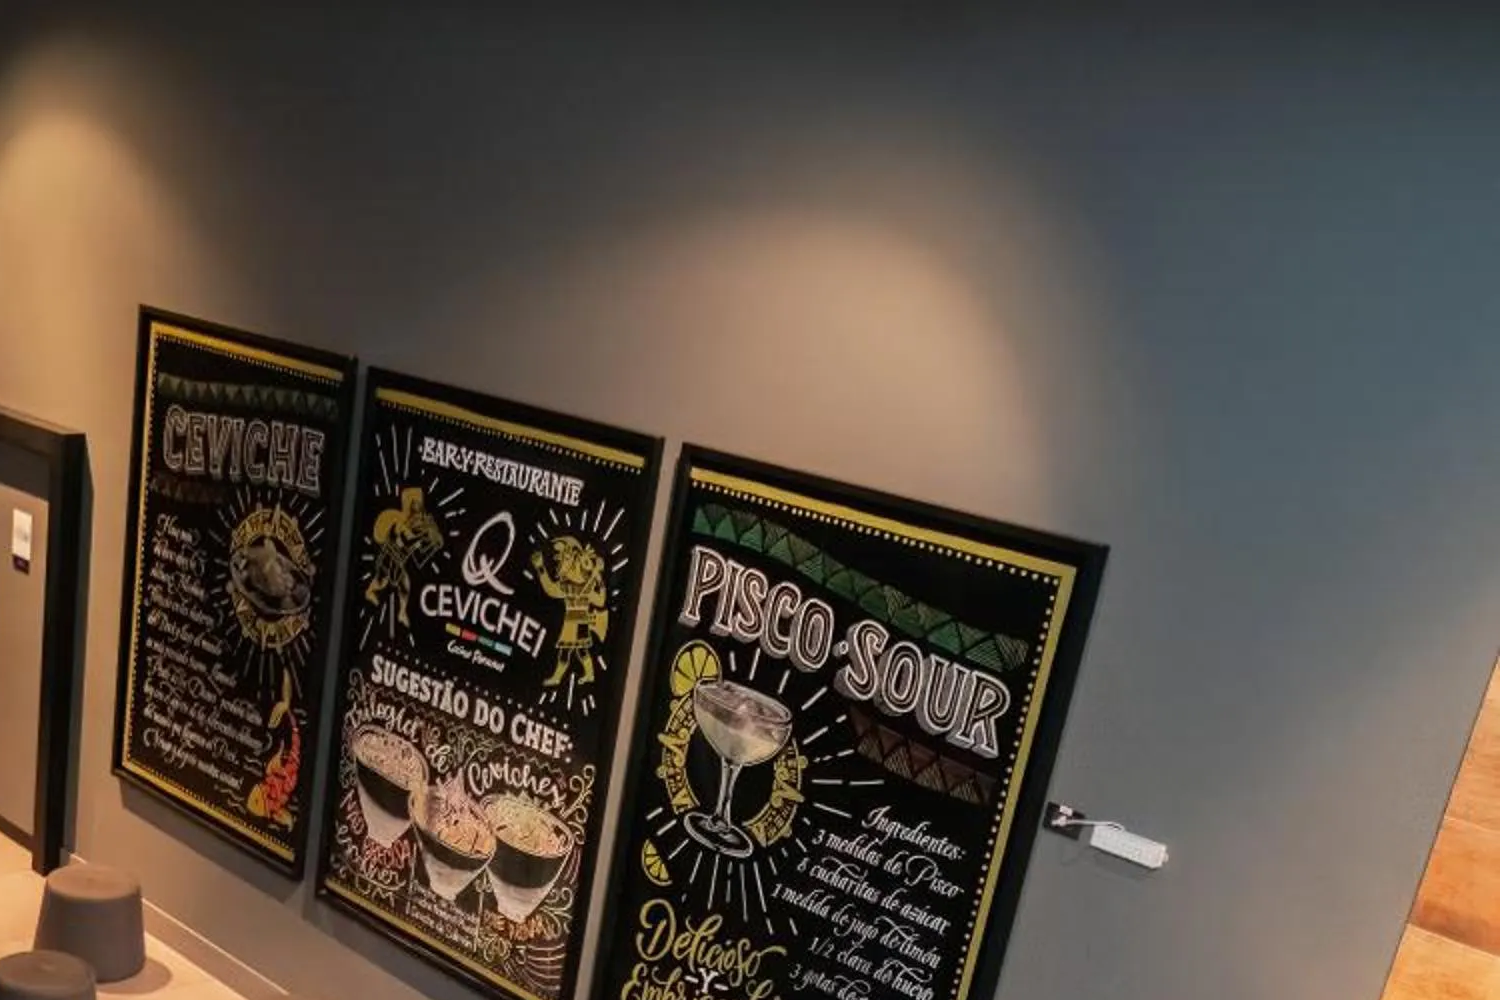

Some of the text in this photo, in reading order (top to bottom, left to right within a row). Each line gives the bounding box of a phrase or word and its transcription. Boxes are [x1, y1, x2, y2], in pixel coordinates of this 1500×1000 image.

[163, 404, 325, 498] CEVICHE
[472, 451, 585, 507] RESTAURANTE
[461, 510, 515, 595] Q
[678, 545, 1010, 759] PISCO SOUR
[371, 654, 574, 764] SUGESTÃO DO CHEF:
[811, 829, 965, 899] 3 medidas de Pisco
[861, 805, 967, 861] Ingredientes:
[782, 887, 836, 920] medida
[831, 903, 856, 926] de
[808, 855, 882, 905] cucharitas
[880, 888, 908, 911] de
[635, 898, 789, 988] Delicioso
[788, 962, 802, 980] 3
